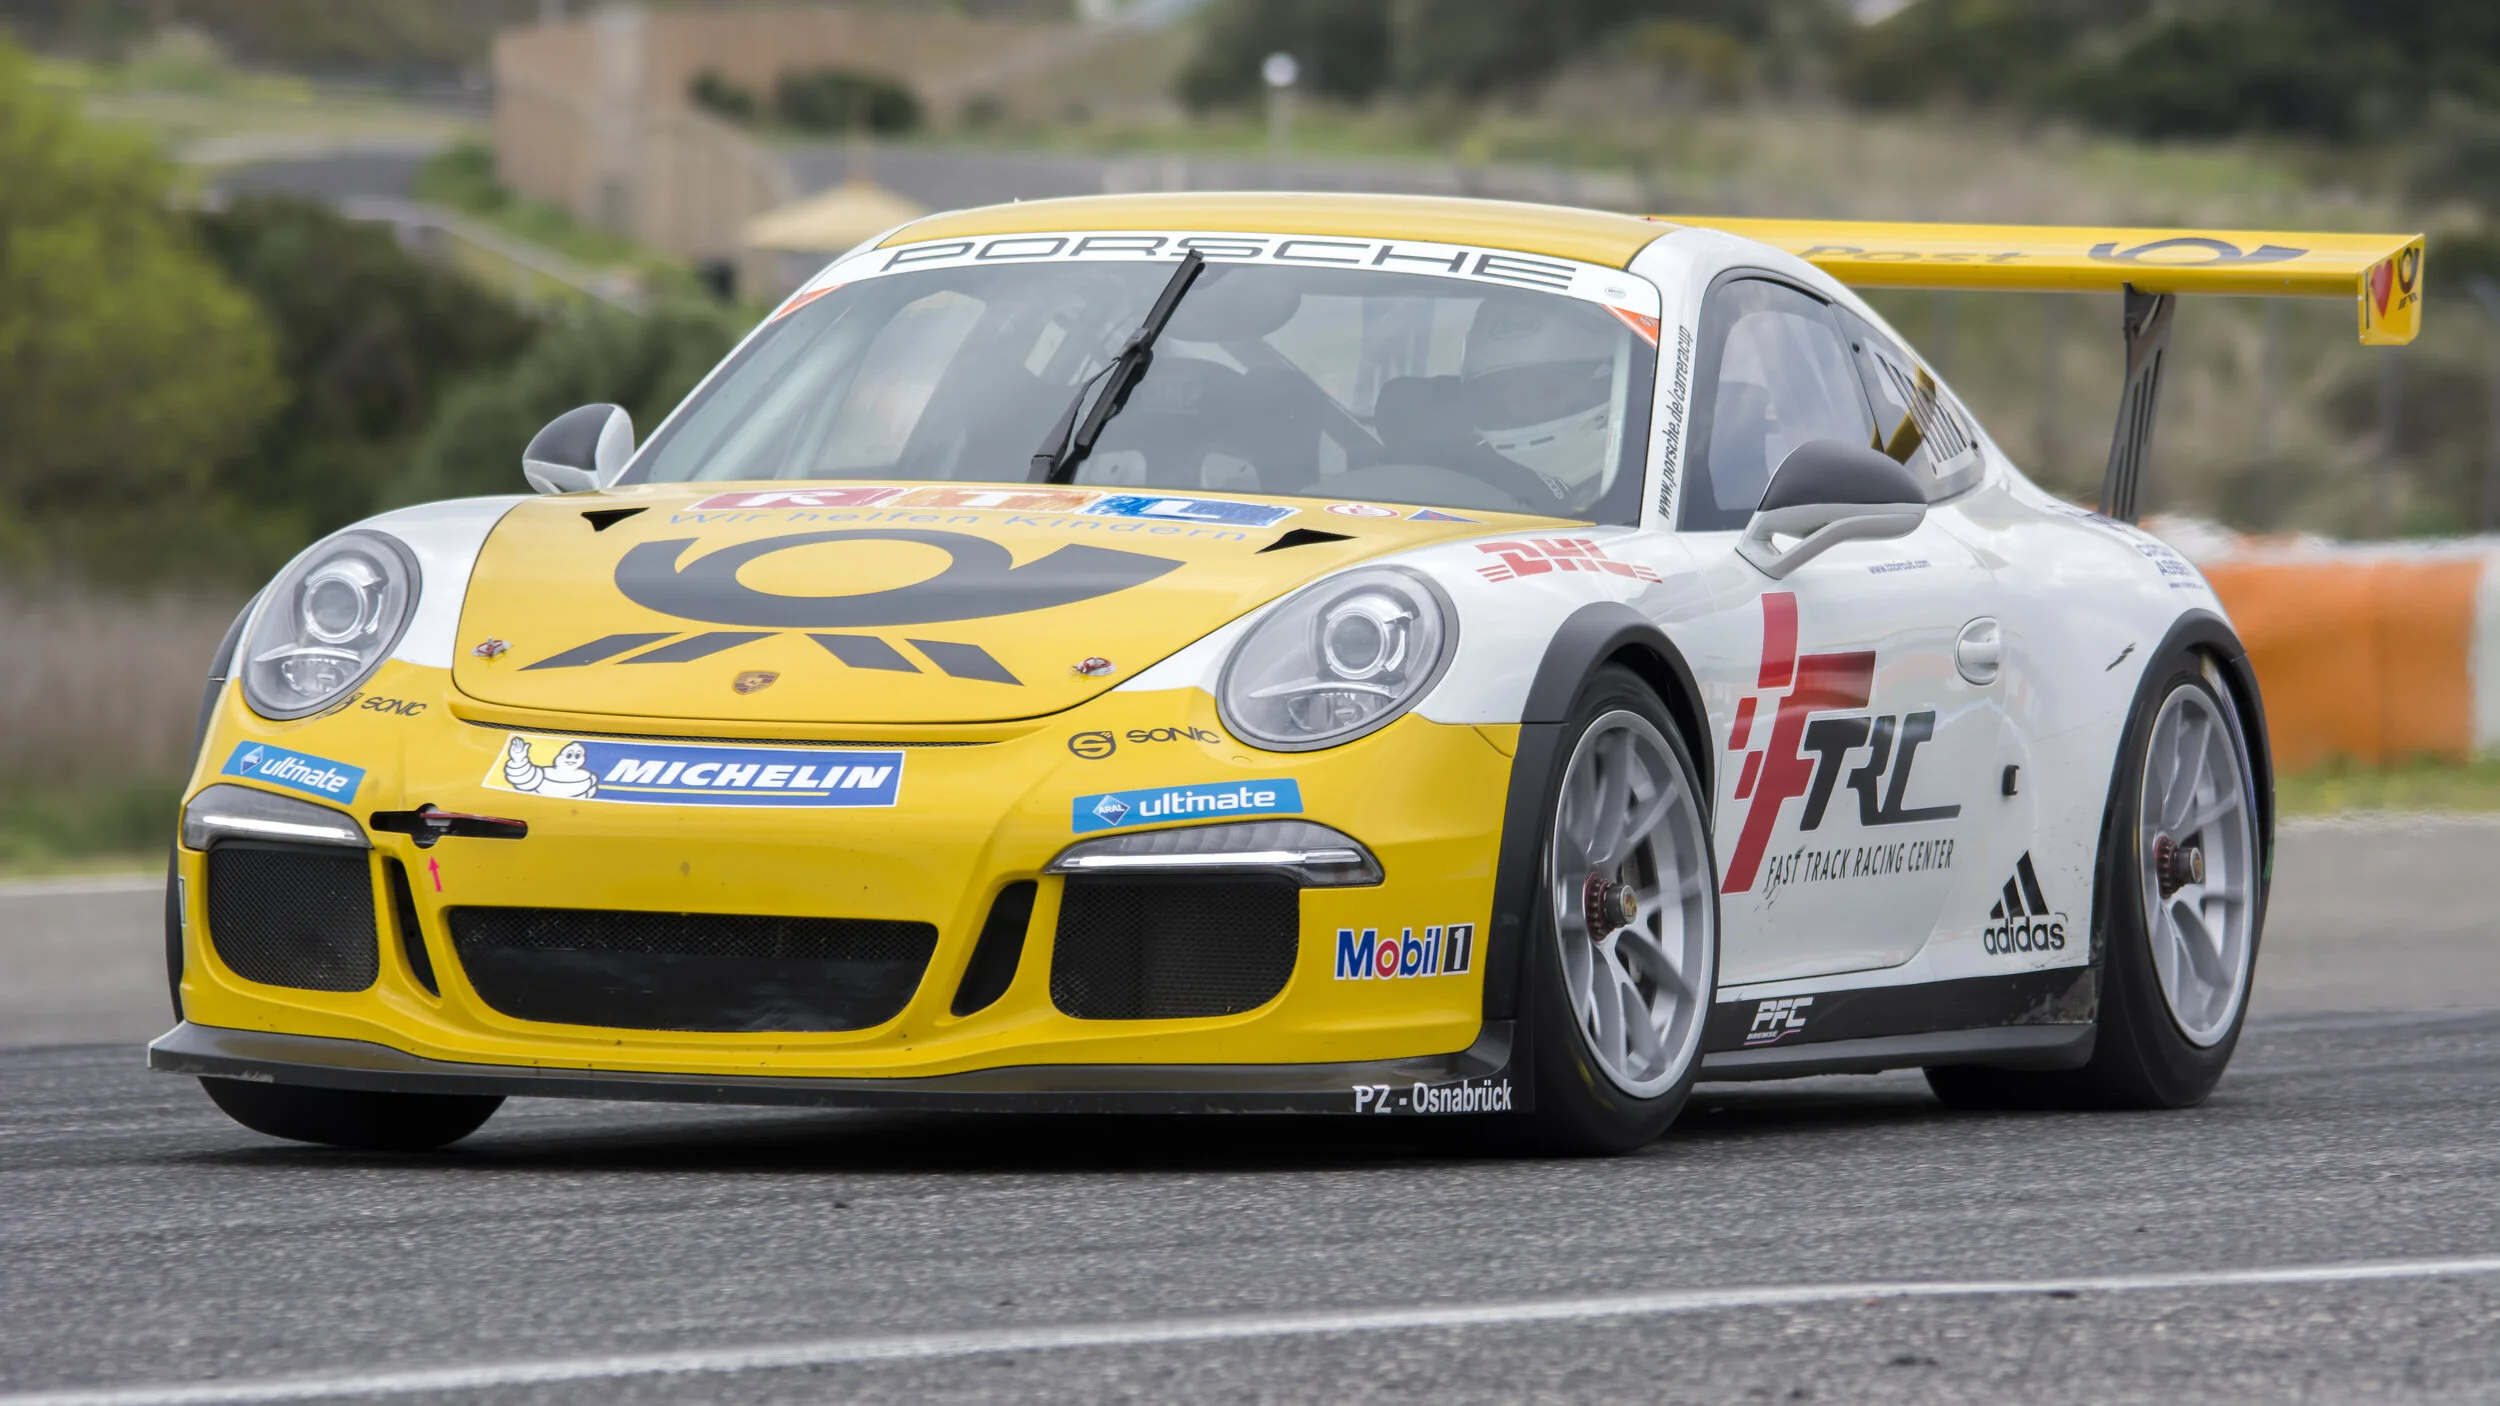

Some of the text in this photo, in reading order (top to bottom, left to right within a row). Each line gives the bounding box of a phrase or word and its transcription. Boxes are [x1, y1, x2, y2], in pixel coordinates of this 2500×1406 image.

[880, 236, 1577, 290] PORSCHE
[1797, 246, 2029, 264] Post
[1658, 324, 1694, 519] www.porsche.de/carreracup
[732, 490, 1222, 520] RTL
[669, 511, 1247, 541] Wir helfen Kindern
[1474, 538, 1640, 578] DHL
[361, 696, 427, 716] SONIC
[1126, 726, 1220, 744] SONIC
[260, 757, 350, 793] ultimate
[603, 758, 893, 789] MICHELIN
[1097, 786, 1276, 817] ARAL ultimate
[1765, 839, 1954, 887] FAST TRACK RACING CENTER
[1335, 927, 1442, 979] Mobil
[1984, 916, 2065, 955] adidas
[1751, 996, 1814, 1032] PFC
[1352, 1078, 1512, 1114] PZ - Osnabrück
